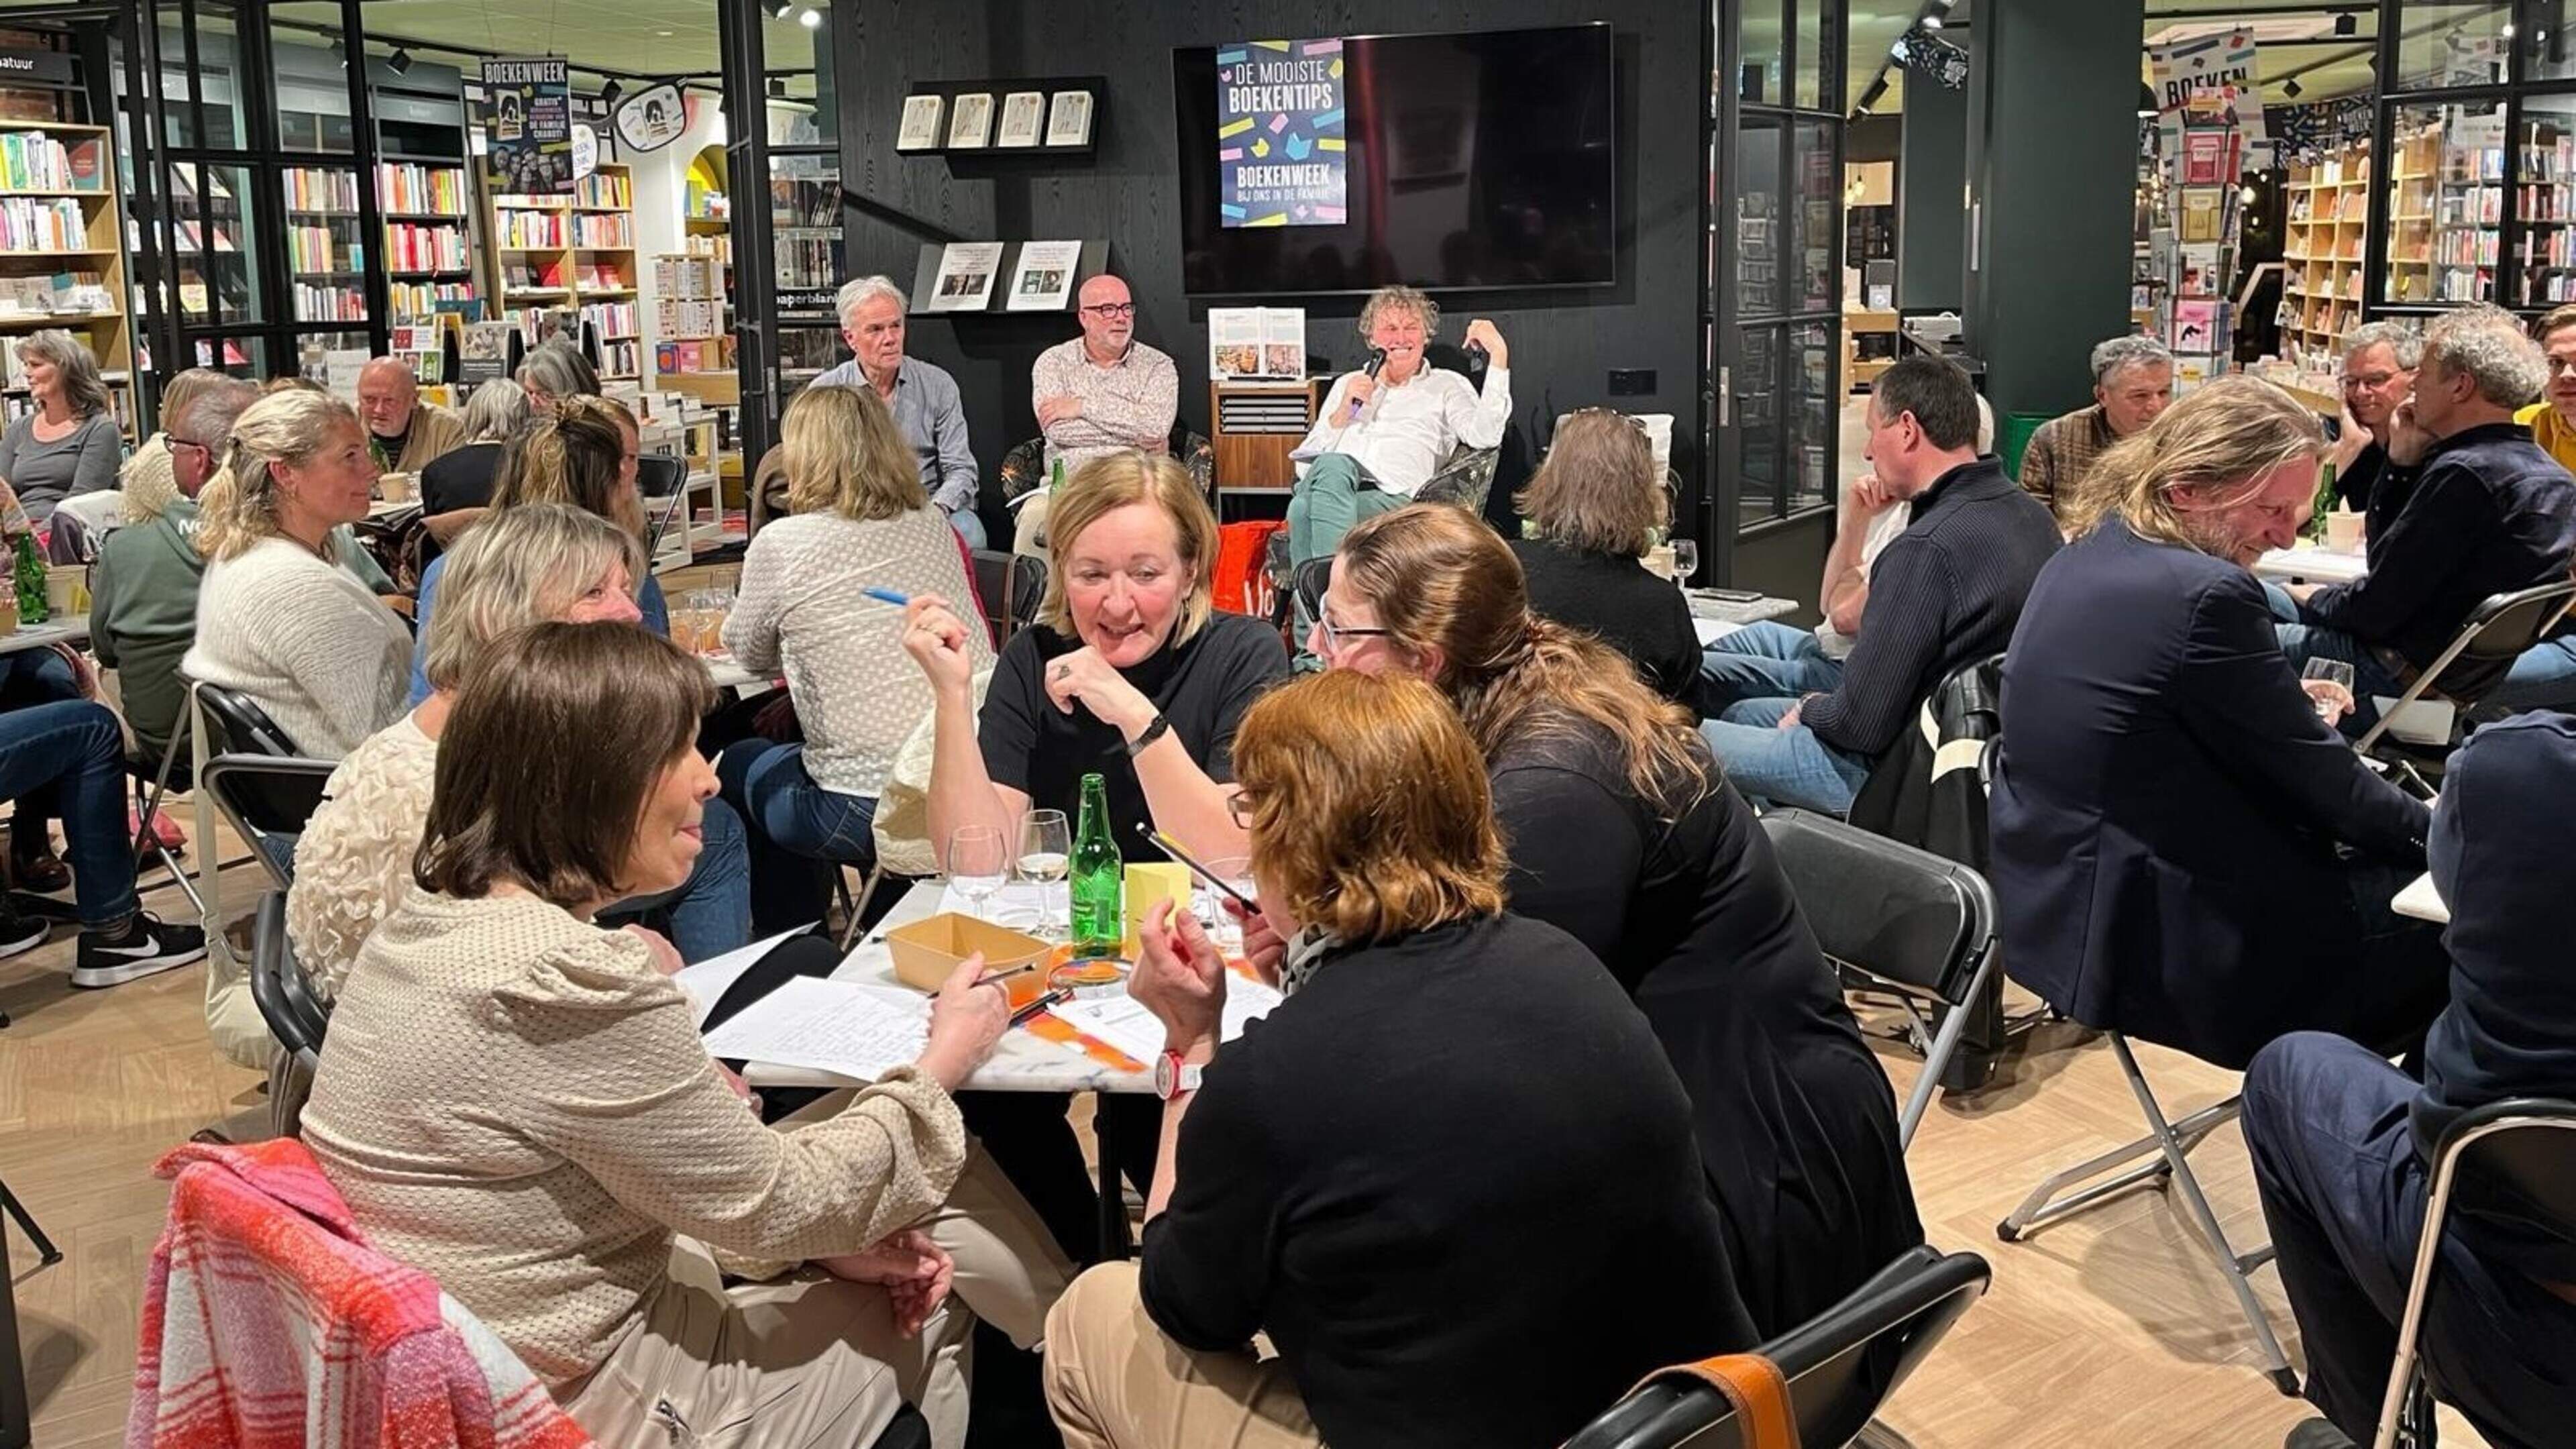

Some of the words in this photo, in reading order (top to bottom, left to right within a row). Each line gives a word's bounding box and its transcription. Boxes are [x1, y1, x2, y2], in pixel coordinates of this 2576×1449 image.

[484, 62, 566, 83] BOEKENWEEK
[1236, 64, 1254, 84] DE
[1260, 60, 1326, 83] MOOISTE
[1229, 84, 1332, 113] BOEKENTIPS
[1237, 164, 1330, 189] BOEKENWEEK
[1237, 190, 1250, 202] BIJ
[1253, 189, 1271, 201] ONS
[1273, 189, 1281, 200] IN
[1284, 189, 1295, 200] DE
